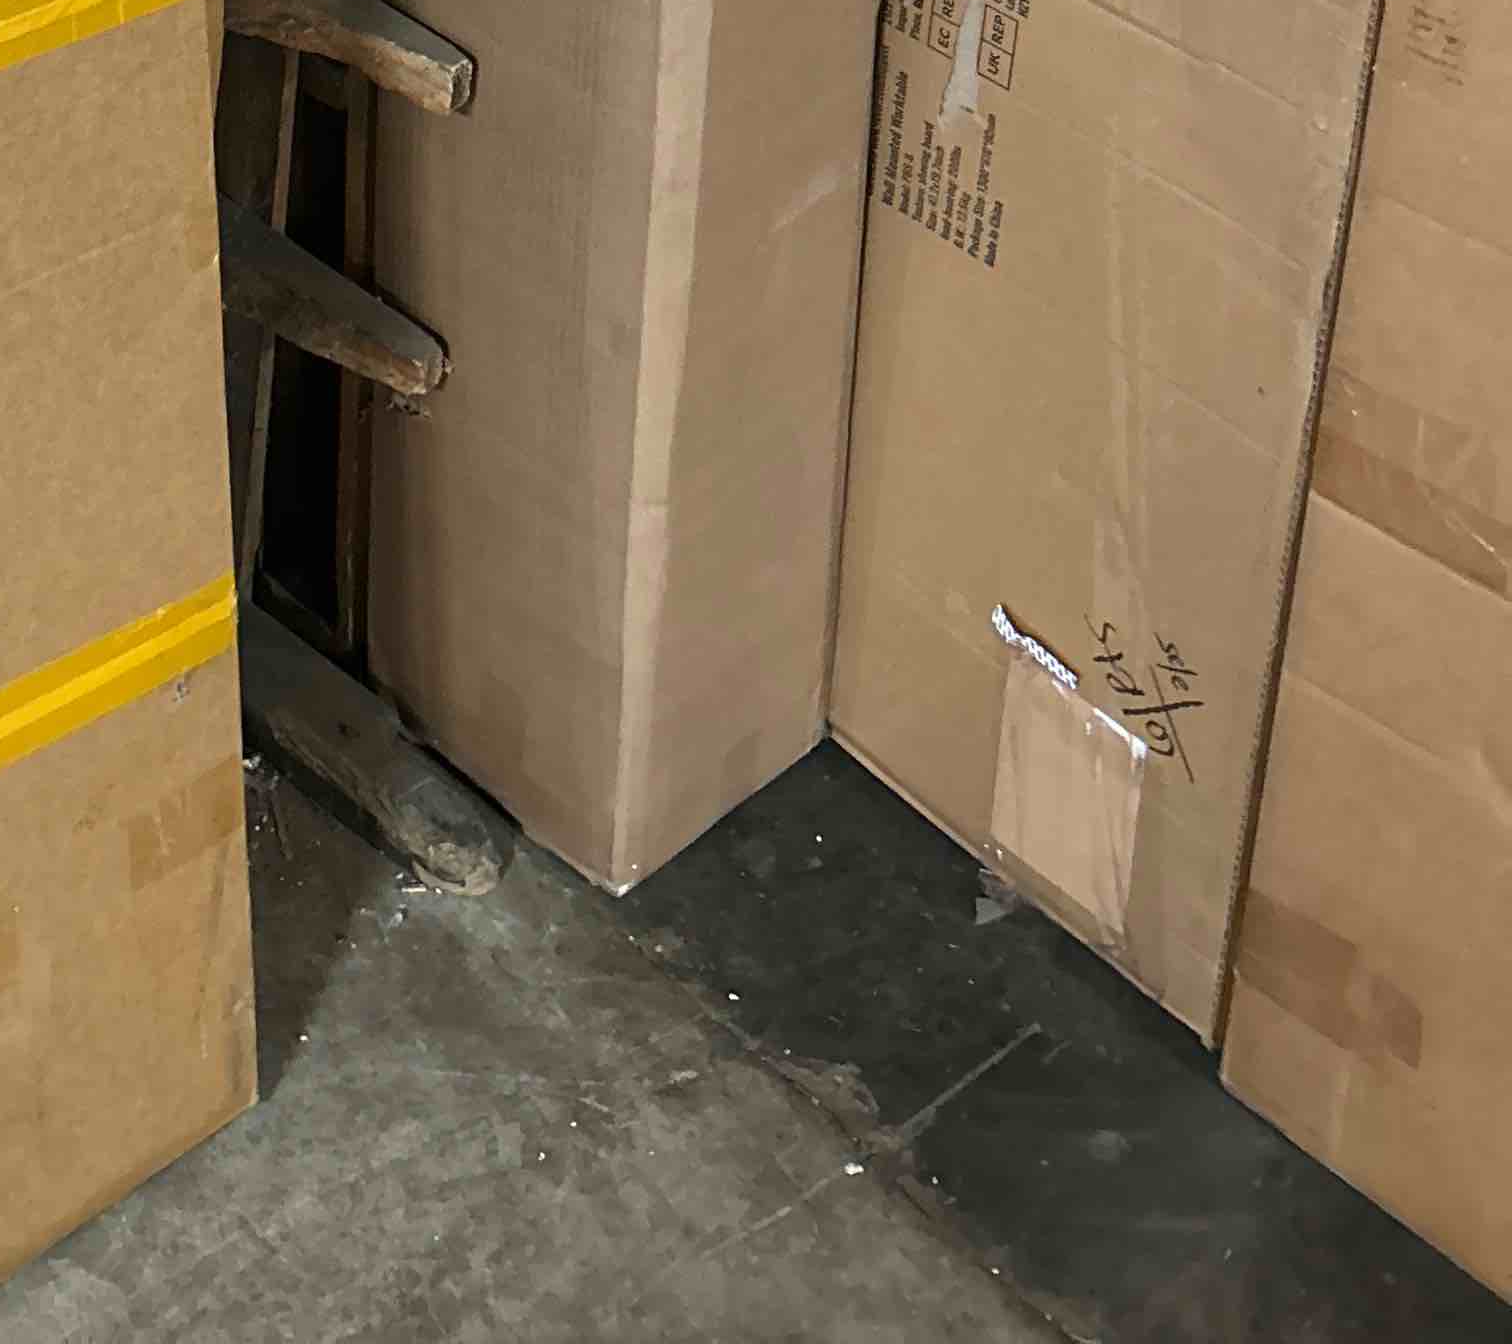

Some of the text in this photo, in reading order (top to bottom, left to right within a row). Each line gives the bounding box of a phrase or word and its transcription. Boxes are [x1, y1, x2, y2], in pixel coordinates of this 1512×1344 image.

[937, 26, 951, 48] EC
[986, 14, 1006, 75] UK REP
